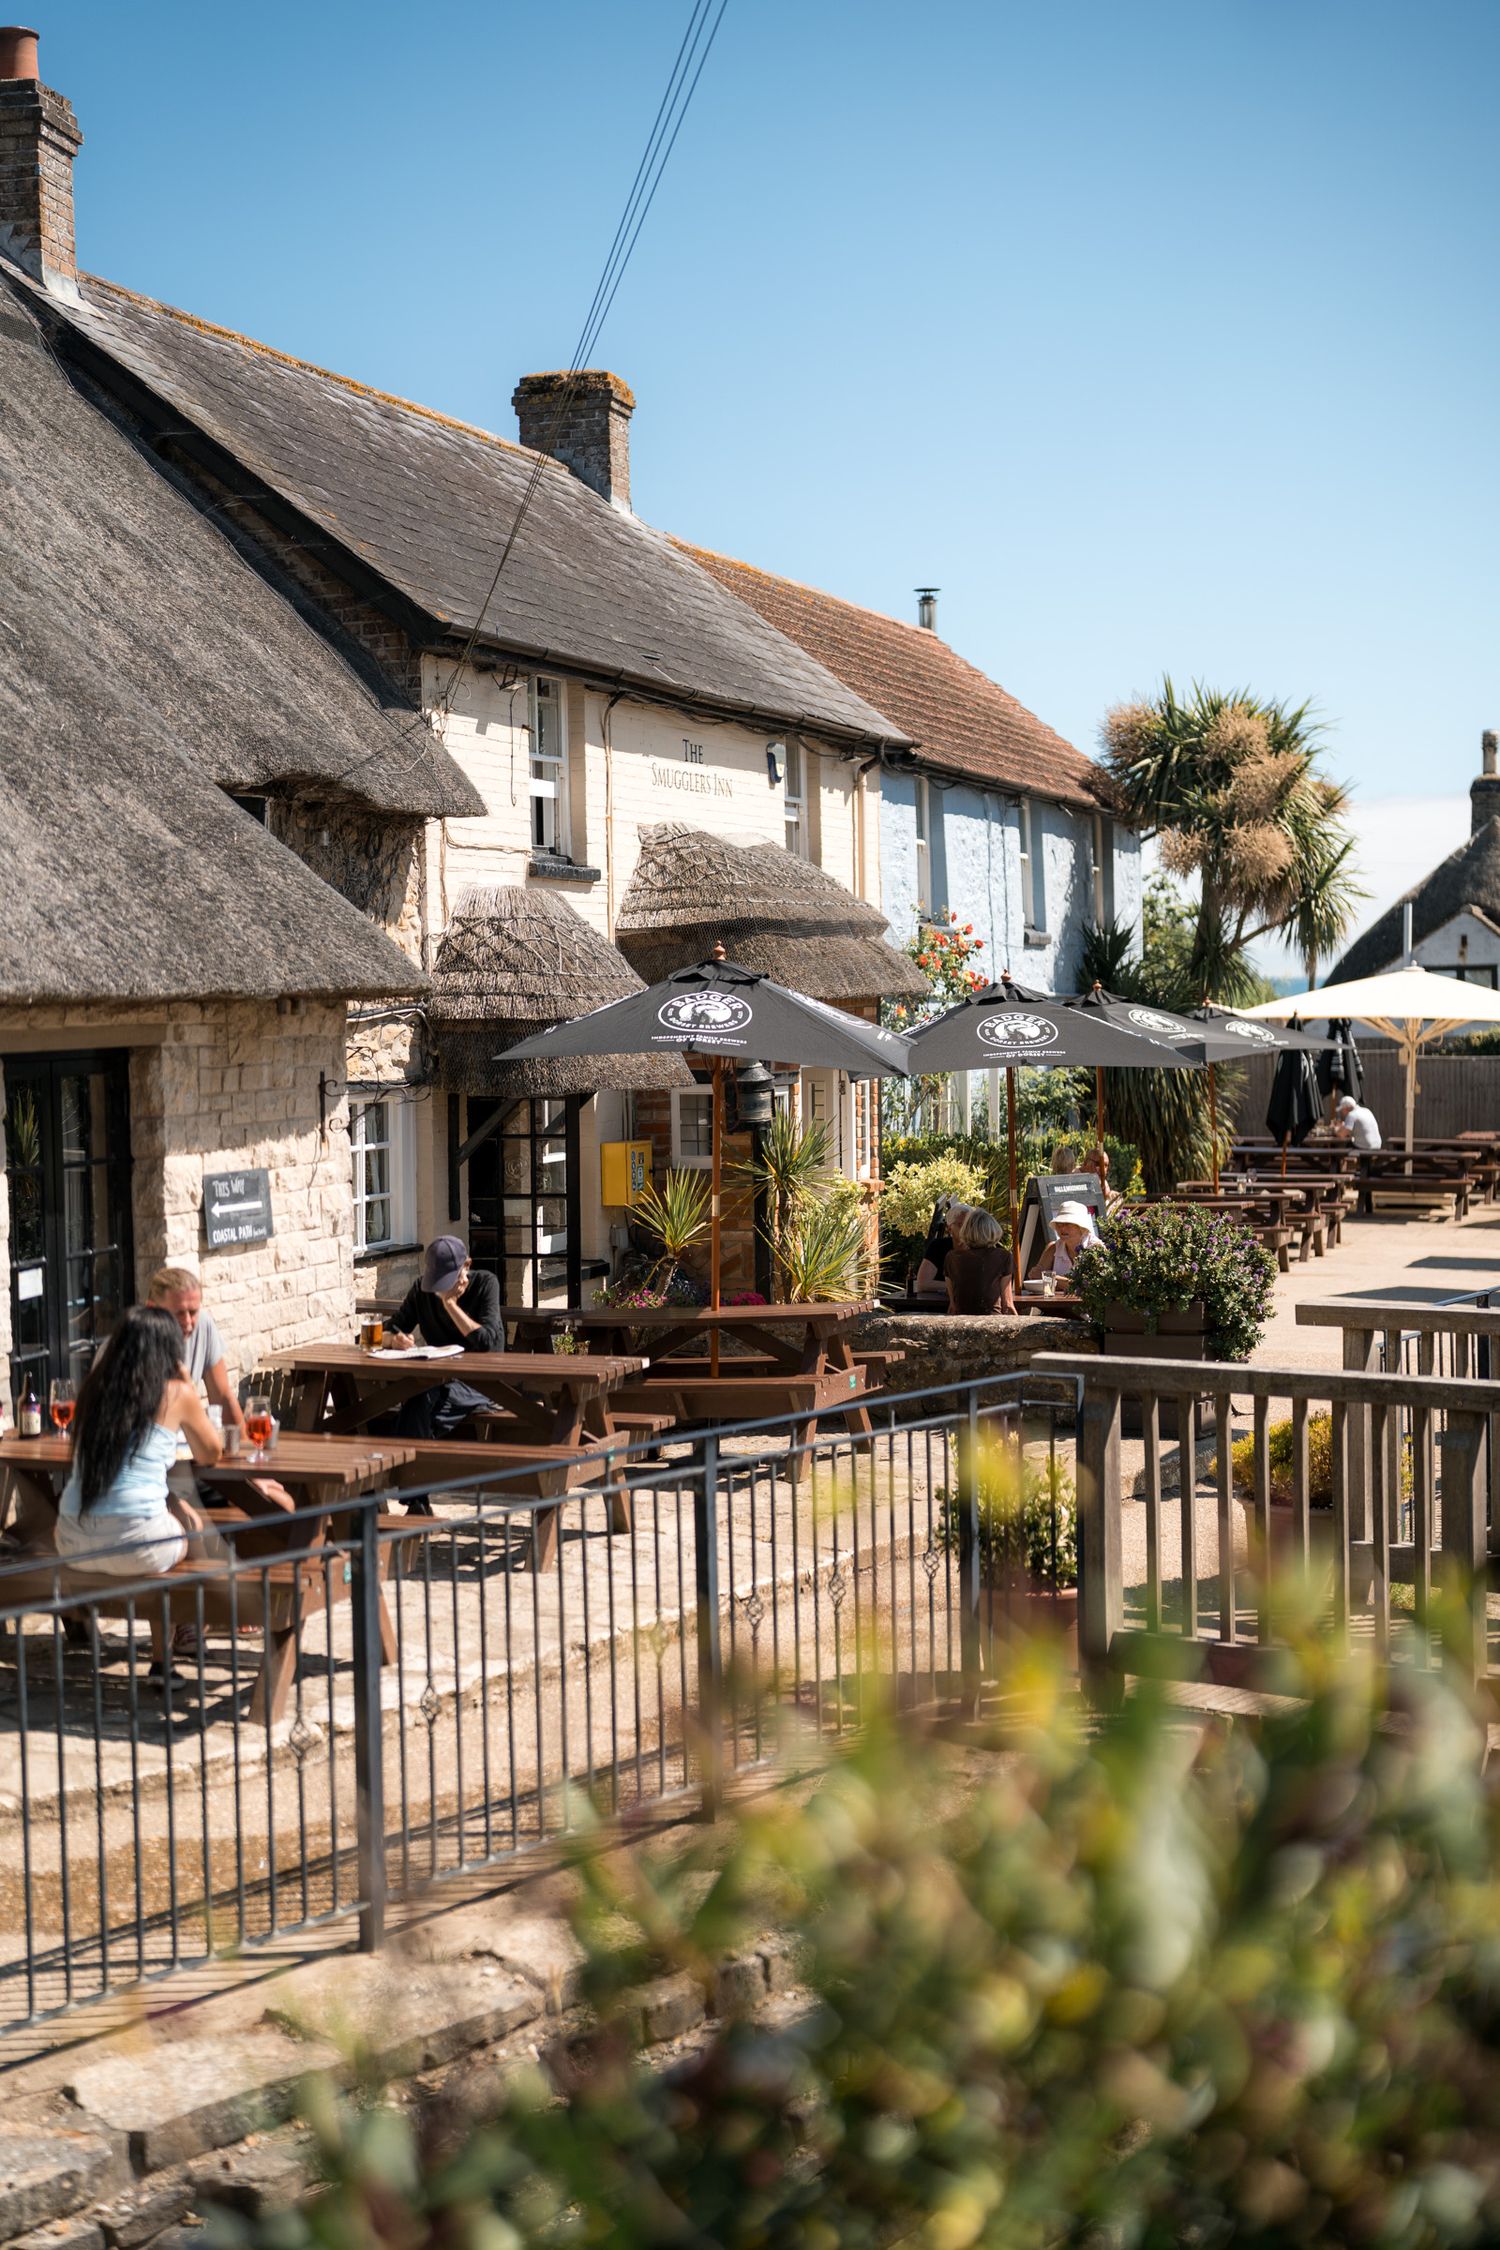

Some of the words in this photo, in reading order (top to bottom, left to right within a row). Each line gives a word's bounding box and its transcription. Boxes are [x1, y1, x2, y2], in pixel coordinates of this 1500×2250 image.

[682, 738, 704, 764] THE
[652, 762, 711, 794] SMUGGLERS
[714, 773, 733, 798] INN
[672, 993, 743, 1010] BADGER
[669, 1017, 697, 1029] DORSET
[699, 1019, 738, 1029] BREWERS
[984, 1014, 1046, 1028] BADGER
[690, 1037, 721, 1045] DORSET
[212, 1180, 230, 1197] THIS
[212, 1227, 238, 1244] COASTAL
[238, 1224, 253, 1240] PATH
